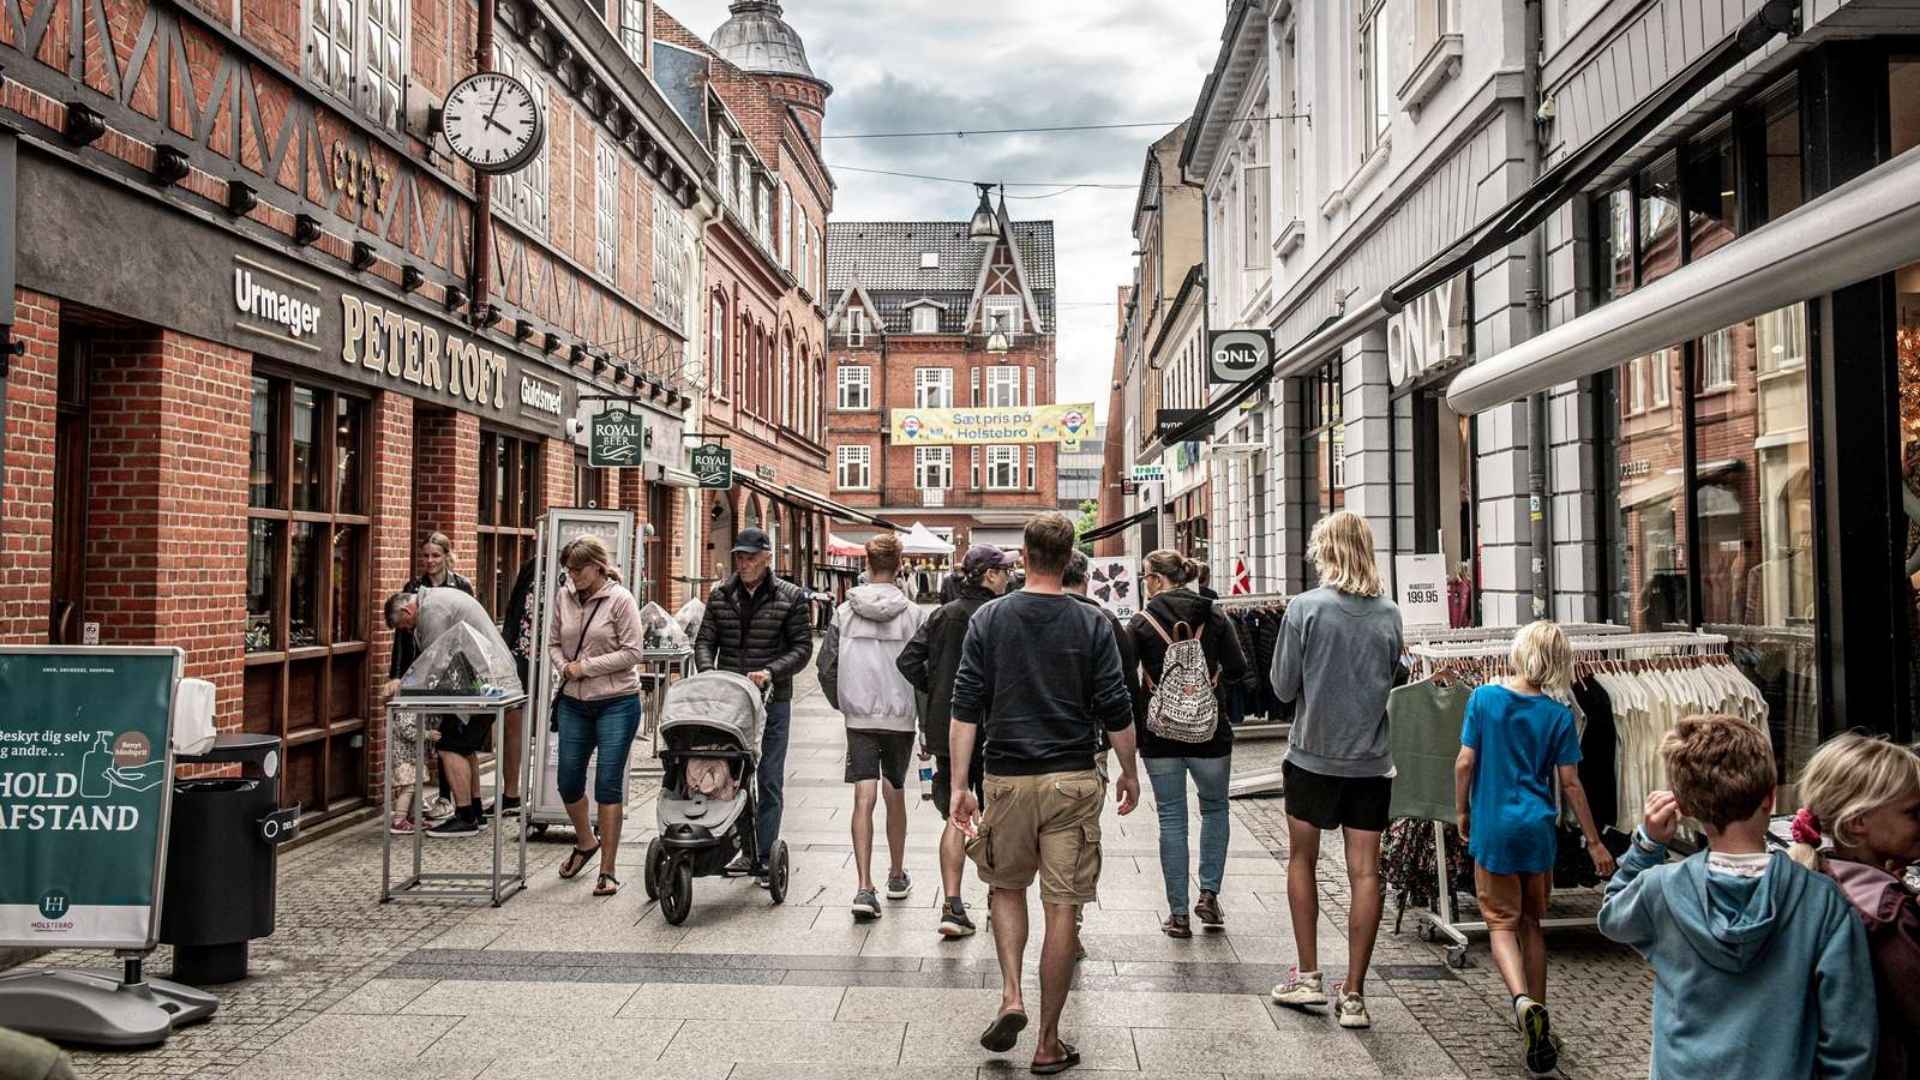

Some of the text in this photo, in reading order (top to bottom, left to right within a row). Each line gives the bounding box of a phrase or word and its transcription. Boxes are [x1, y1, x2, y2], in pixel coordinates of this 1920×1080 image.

[234, 268, 320, 338] Urmager
[1387, 272, 1467, 387] ONLY
[341, 293, 508, 409] PETER TOFT
[1215, 349, 1264, 363] ONLY
[520, 375, 562, 415] Guldsmed
[953, 411, 1032, 427] Sæt pris på
[595, 424, 639, 437] ROYAL
[957, 428, 1028, 438] Holstebro
[603, 436, 630, 446] BEER
[695, 455, 728, 466] ROYAL
[1407, 590, 1439, 604] 199.95
[42, 730, 61, 745] dig
[64, 730, 90, 743] selv
